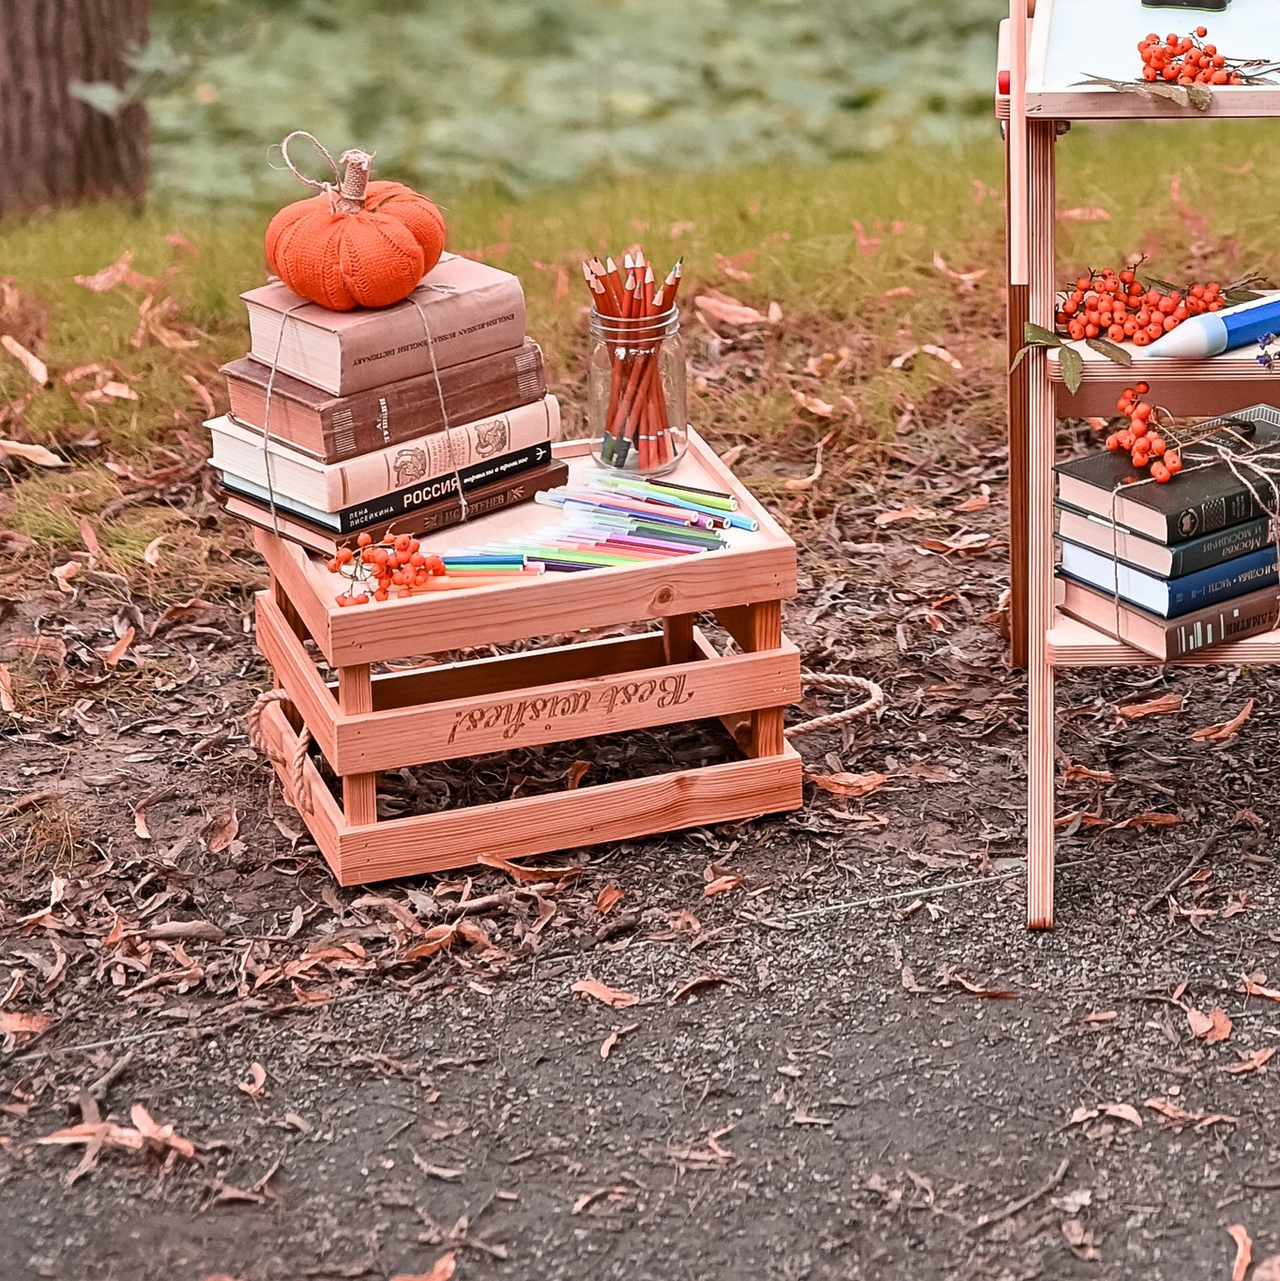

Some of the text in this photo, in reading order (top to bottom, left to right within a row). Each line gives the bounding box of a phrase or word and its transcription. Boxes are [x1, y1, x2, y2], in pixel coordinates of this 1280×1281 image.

[352, 313, 515, 367] ENGLISH-RUSSIAN RUSSIAENGLISH DICTIONARY
[403, 477, 460, 508] РОССИЯ
[1203, 529, 1252, 553] МОСКВИЧИ
[1222, 536, 1261, 556] Москва
[447, 673, 694, 745] Best wishes!
